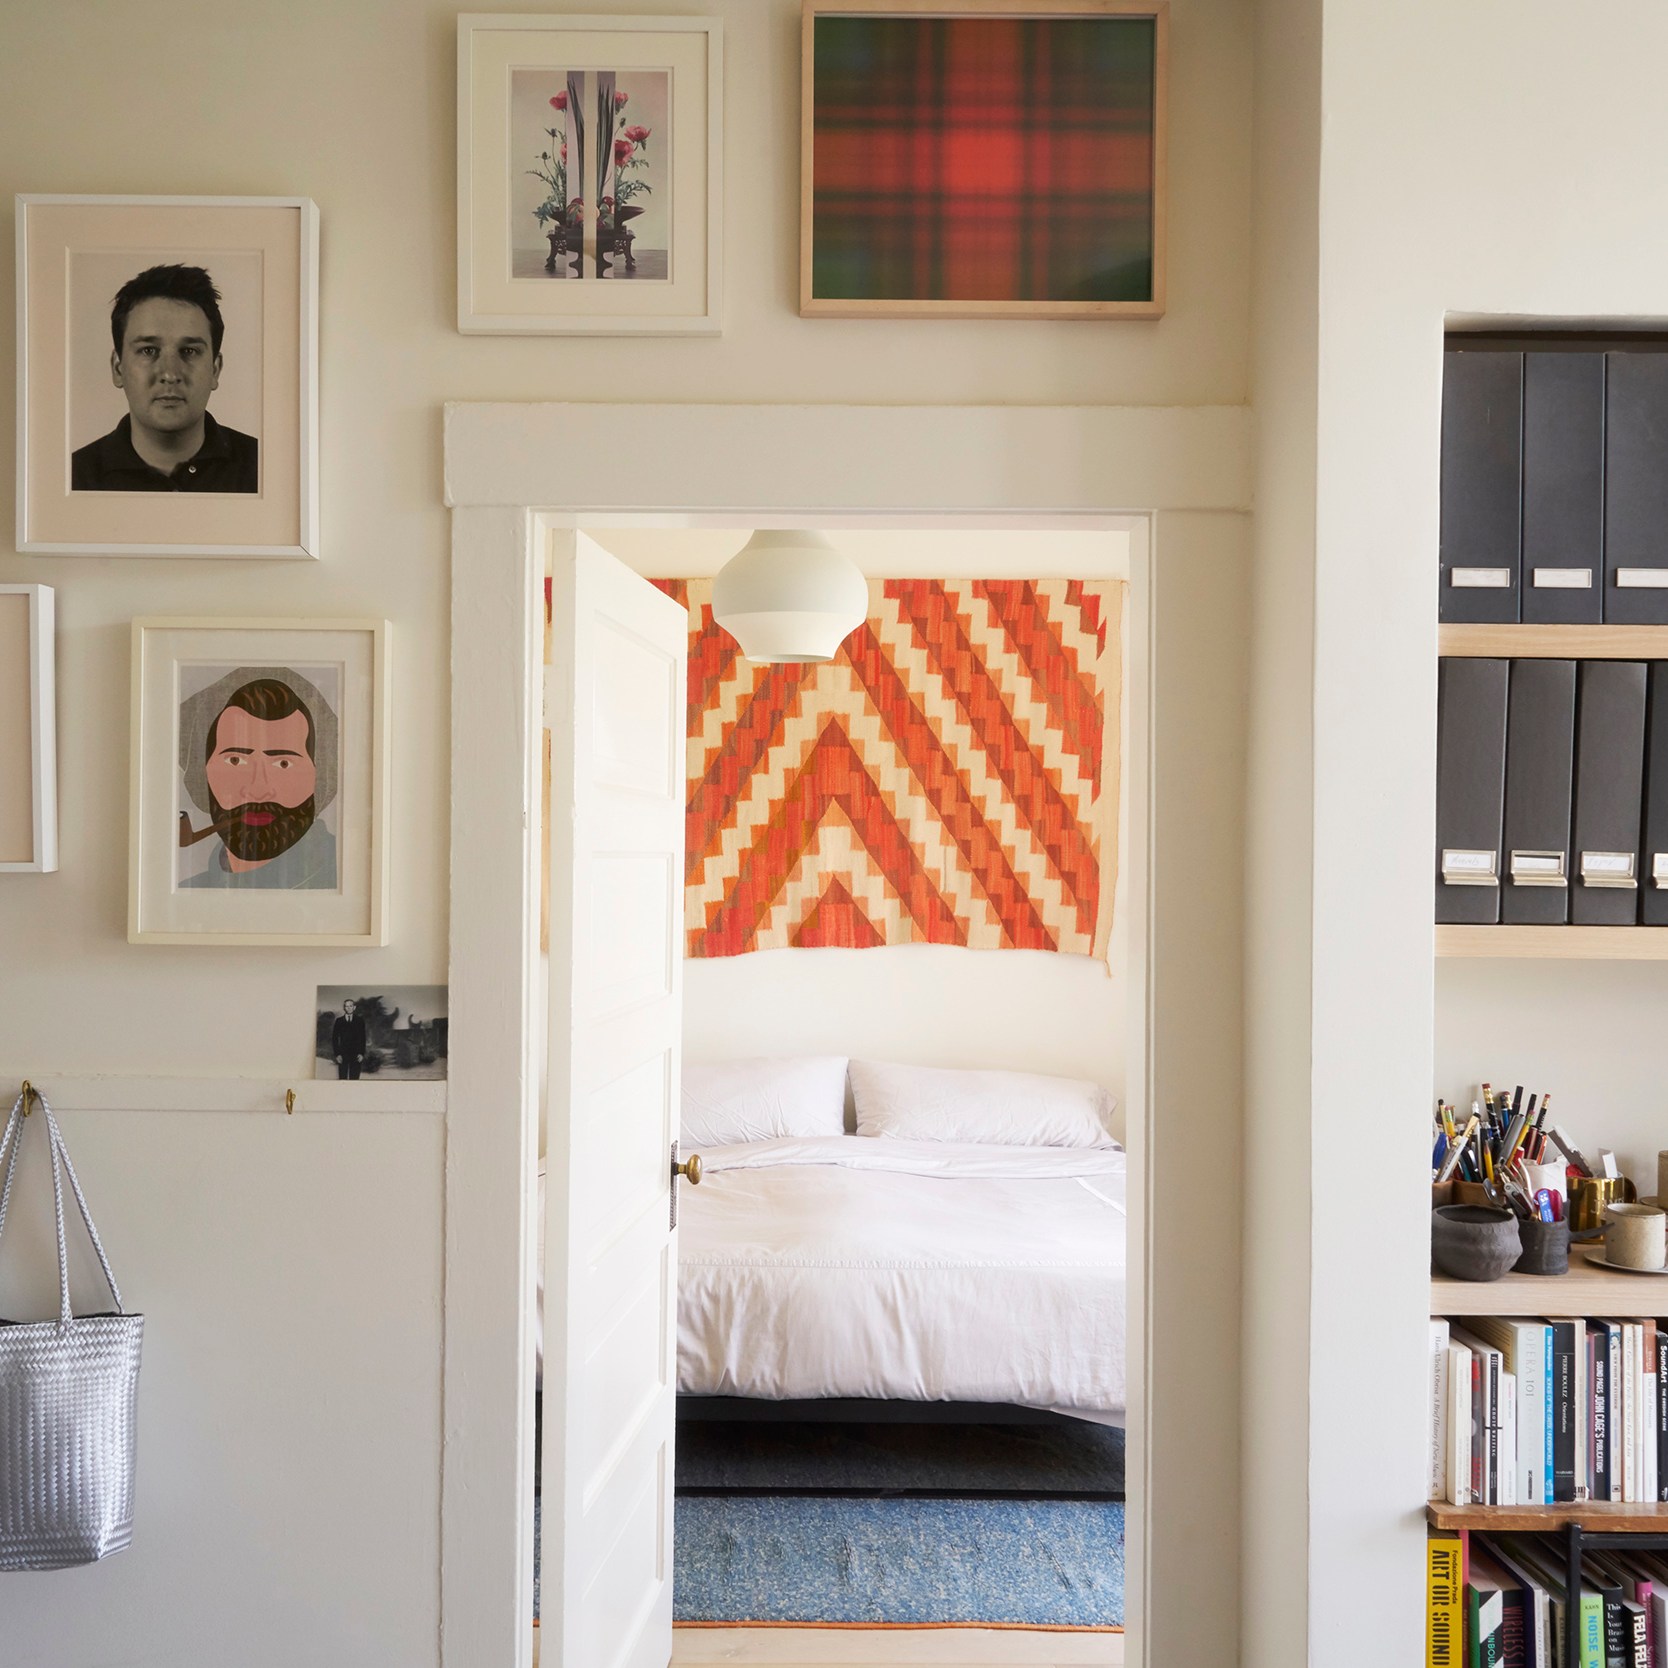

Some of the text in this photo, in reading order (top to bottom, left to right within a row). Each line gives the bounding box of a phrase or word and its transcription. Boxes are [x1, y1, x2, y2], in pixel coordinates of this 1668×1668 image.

[1526, 1332, 1537, 1374] OPERA
[1660, 1346, 1668, 1383] SoundArt
[1526, 1380, 1534, 1397] 101
[1432, 1403, 1440, 1419] Brief
[1594, 1360, 1605, 1473] SOUND PAGES JOHN CAGE'S PUBLICATIONS
[1432, 1419, 1440, 1440] History
[1432, 1550, 1450, 1666] ART OR SOUND
[1503, 1606, 1524, 1658] WIRELESS
[1588, 1616, 1598, 1652] NOISE
[1634, 1614, 1646, 1644] FELA
